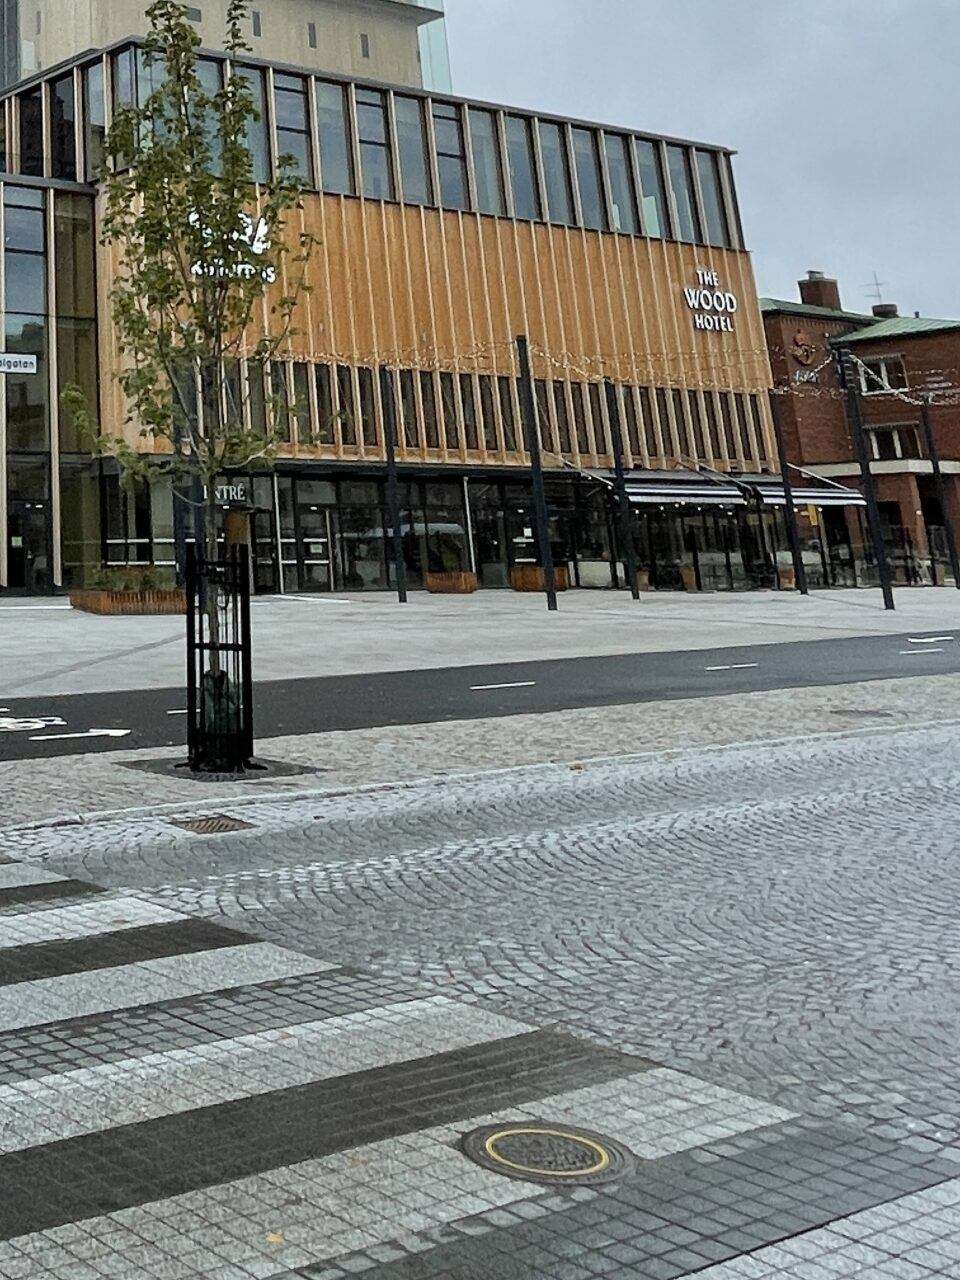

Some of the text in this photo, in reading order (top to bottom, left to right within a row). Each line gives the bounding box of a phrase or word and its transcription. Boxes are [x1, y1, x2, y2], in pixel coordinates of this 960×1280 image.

[696, 269, 719, 286] THE
[683, 287, 738, 313] WOOD
[694, 313, 734, 332] HOTEL
